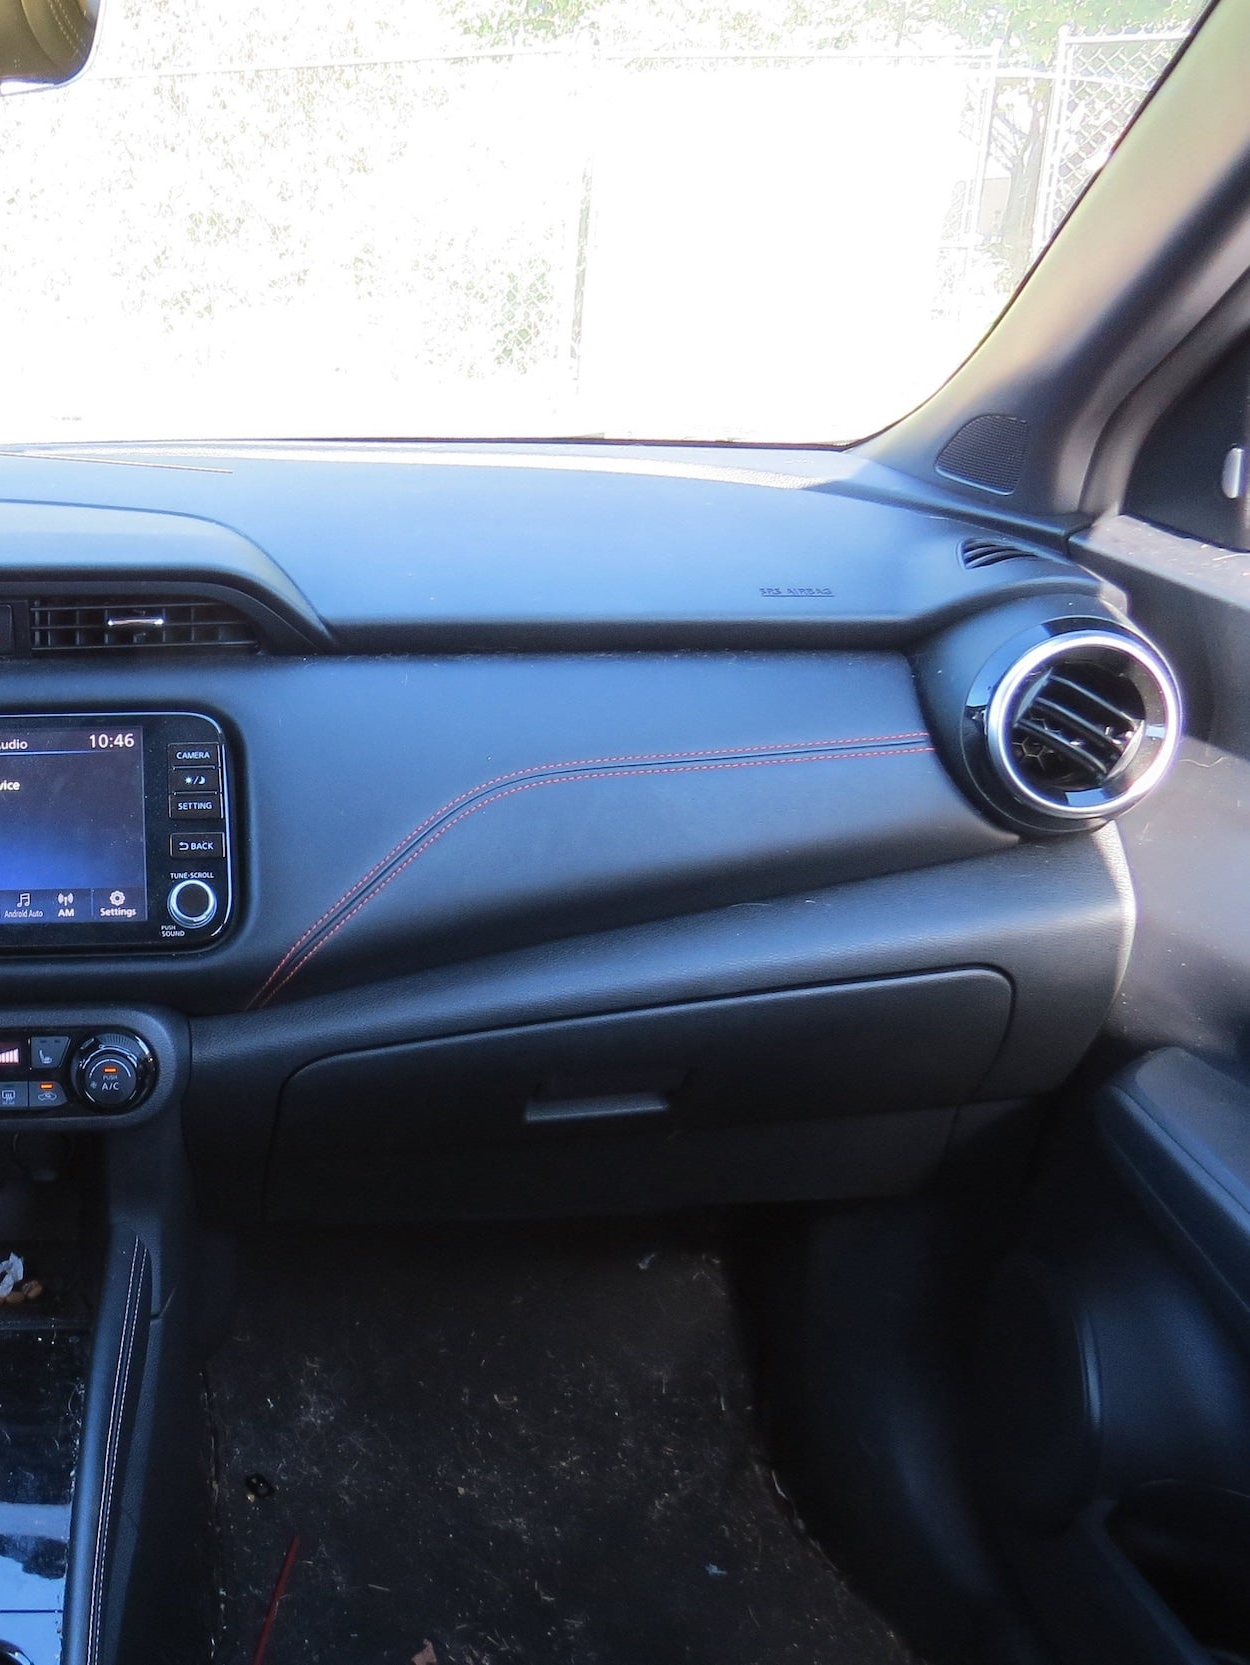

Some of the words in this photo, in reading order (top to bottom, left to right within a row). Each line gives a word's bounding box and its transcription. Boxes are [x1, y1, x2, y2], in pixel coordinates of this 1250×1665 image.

[88, 733, 135, 749] 10:46
[176, 752, 211, 760] CAMERA
[178, 802, 213, 811] SETTING
[190, 841, 214, 851] BACK
[4, 909, 28, 918] Android
[28, 909, 43, 918] Auto
[57, 908, 75, 917] AM
[100, 907, 137, 918] Settings
[102, 1082, 119, 1091] A/C
